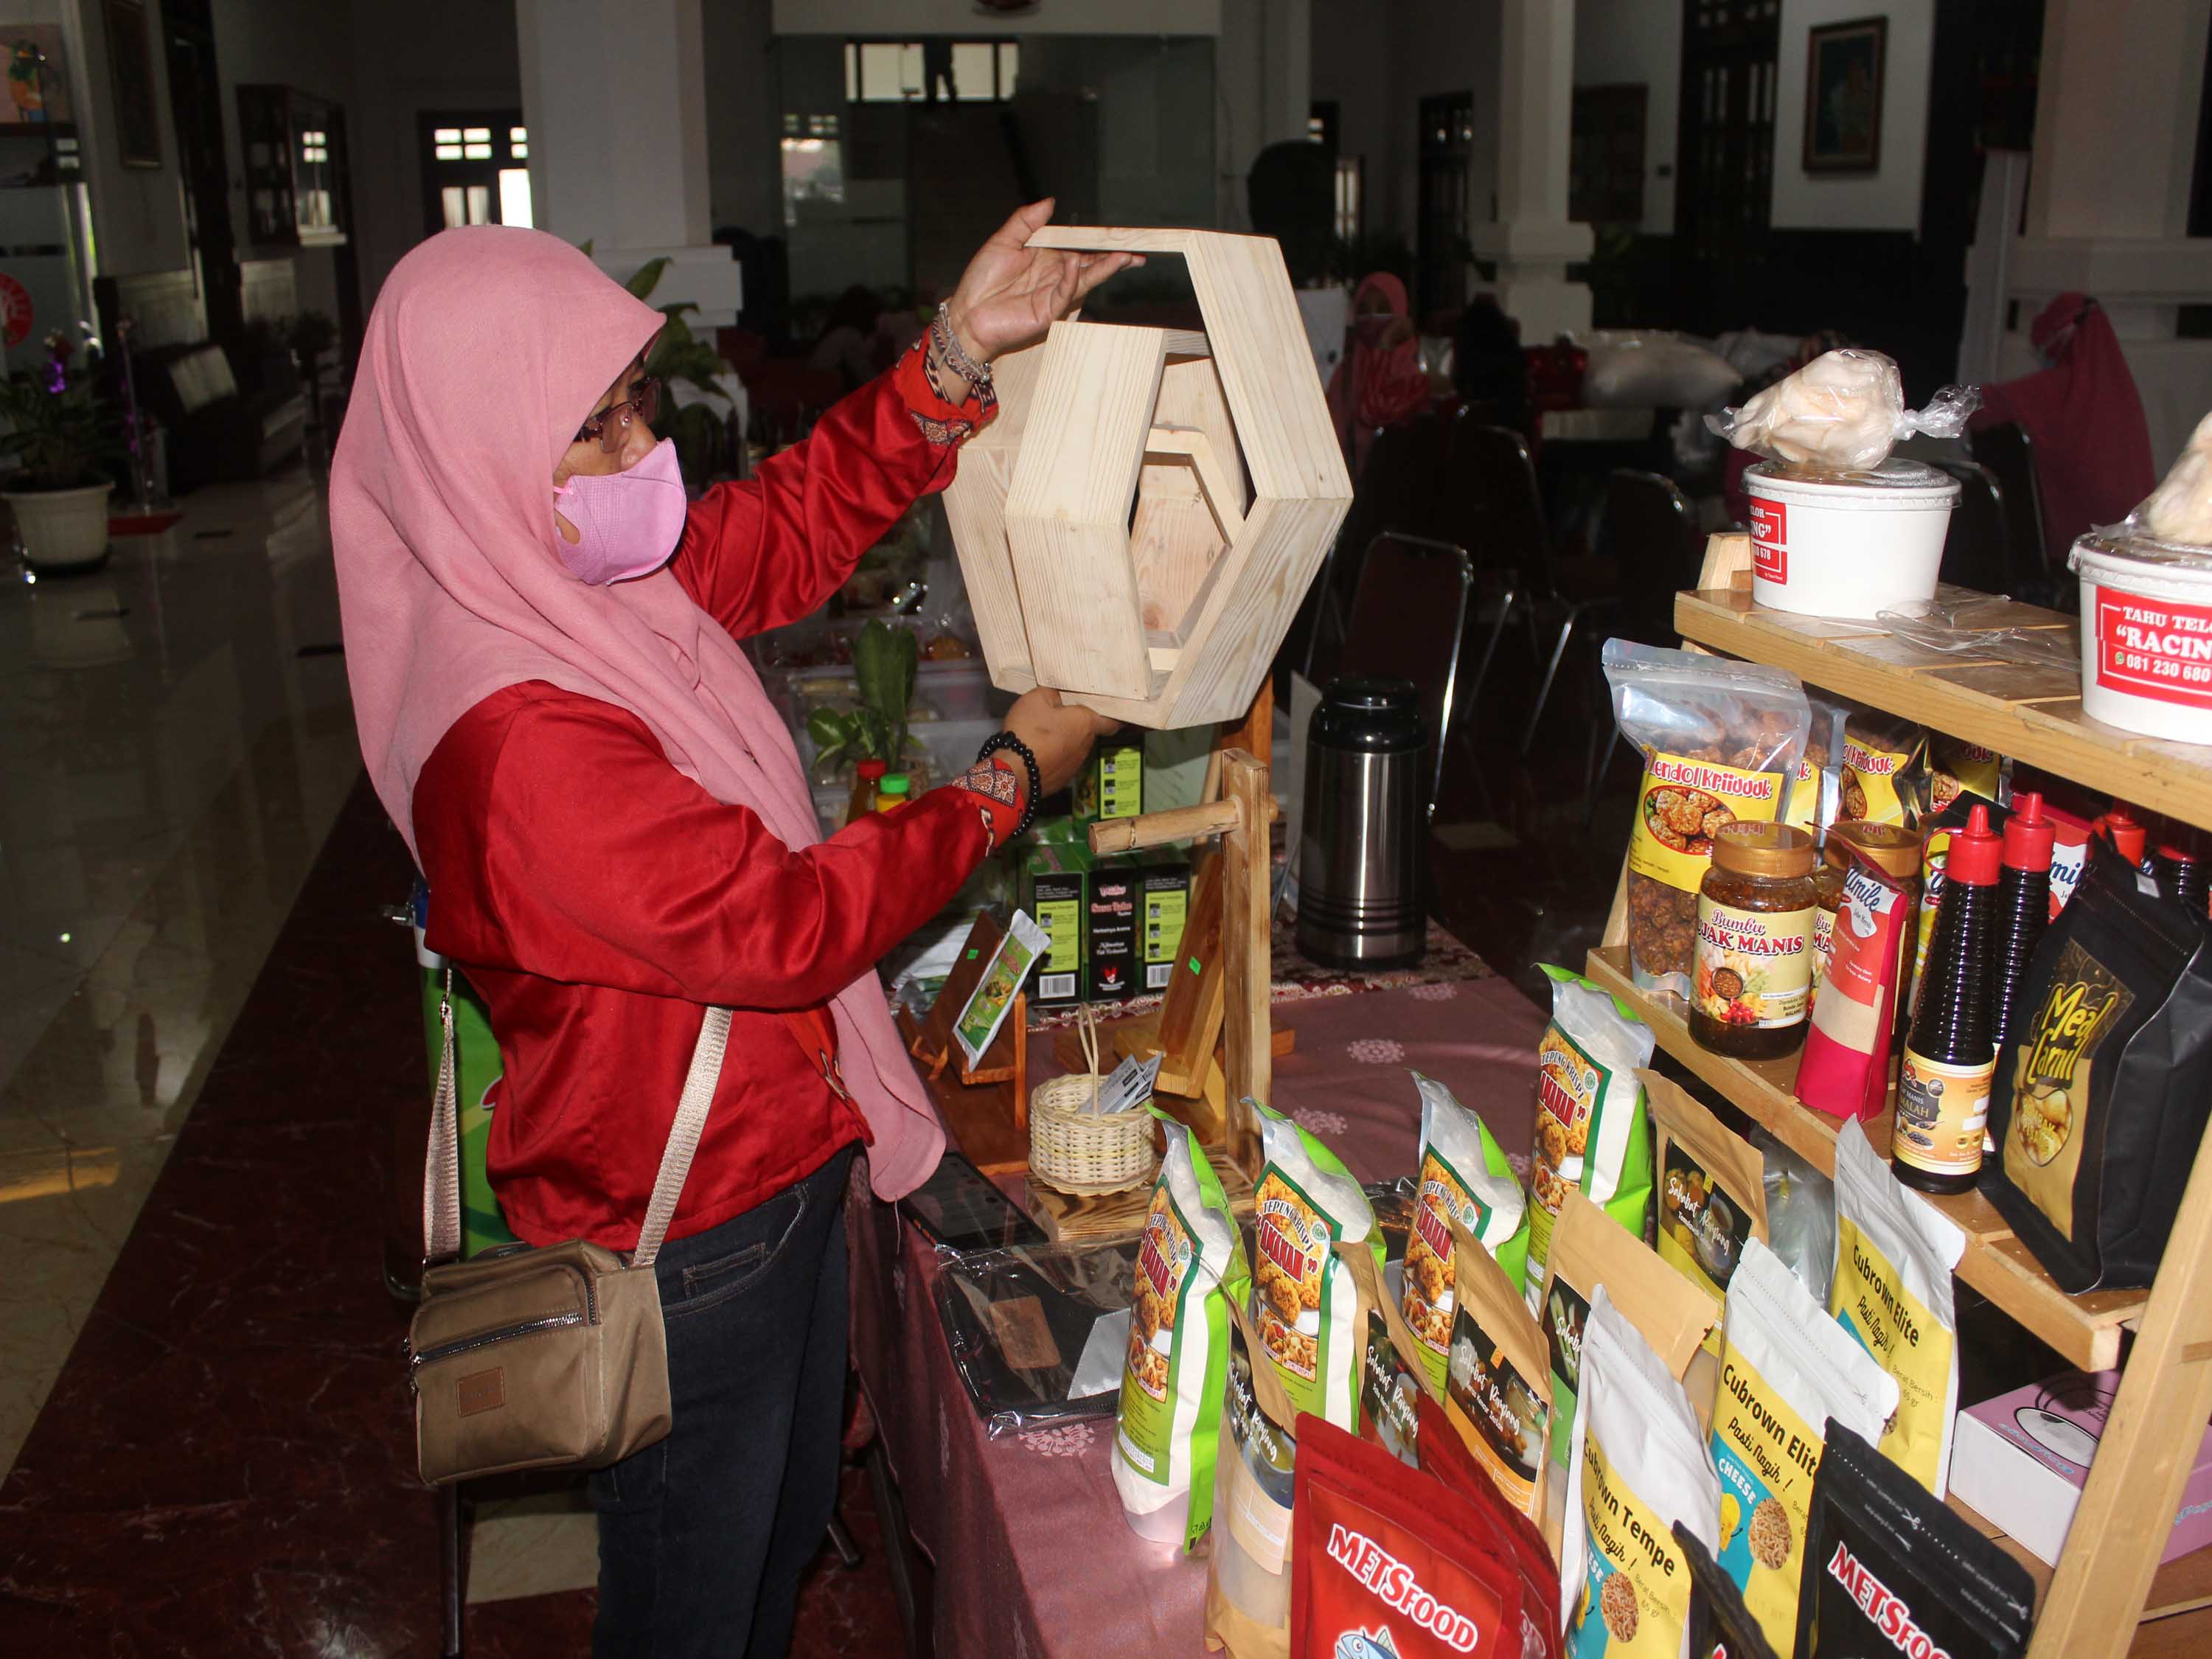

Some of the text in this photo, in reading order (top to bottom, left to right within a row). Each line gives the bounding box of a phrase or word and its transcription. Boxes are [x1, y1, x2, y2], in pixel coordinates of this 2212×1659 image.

[2123, 606, 2212, 634] TAHU TEL
[2126, 654, 2211, 683] 081 230 680
[1651, 760, 1700, 786] endol
[1698, 919, 1733, 950] JAK
[1737, 935, 1805, 956] MANIS
[1711, 908, 1765, 935] Bumbu
[1541, 1051, 1585, 1099] TEPUNG KRISPI
[1424, 1181, 1447, 1200] TEPUNG
[1668, 1177, 1701, 1218] Sahabat
[1263, 1200, 1315, 1253] TEPUNG KRISPI
[1853, 1244, 1919, 1348] Cubrown Elite
[1857, 1295, 1877, 1326] Pasti
[1869, 1317, 1889, 1352] Nagih
[1366, 1345, 1393, 1392] Sahabat
[1459, 1346, 1488, 1391] Sahabat
[1489, 1383, 1520, 1436] Rimpang
[1722, 1363, 1787, 1445] Cubrown
[1787, 1434, 1818, 1478] Elit
[1728, 1415, 1754, 1453] Pasti
[1752, 1442, 1781, 1485] Nagih
[1718, 1456, 1757, 1505] CHEESE
[1584, 1436, 1676, 1577] Cubrown Tempe
[1587, 1549, 1604, 1584] ESE
[1598, 1523, 1627, 1563] Nagih
[1326, 1522, 1479, 1653] METSFOOD
